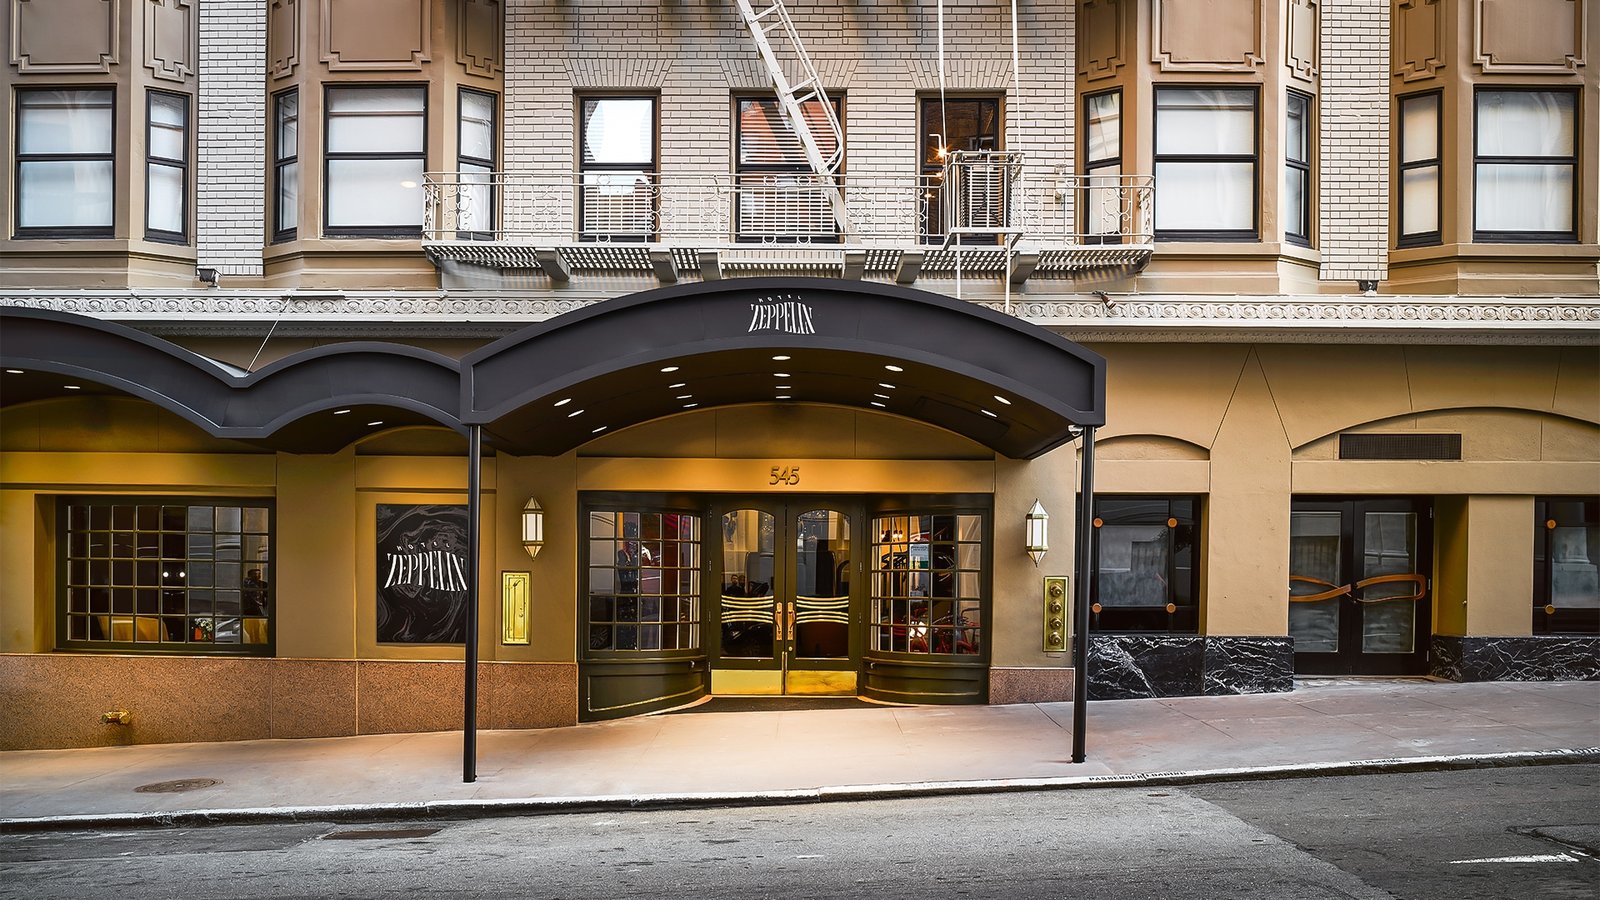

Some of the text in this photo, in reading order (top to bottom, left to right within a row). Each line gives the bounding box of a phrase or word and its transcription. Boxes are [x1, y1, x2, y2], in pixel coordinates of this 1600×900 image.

[758, 294, 802, 303] HOTEL
[748, 302, 816, 335] ZEPPELIN
[769, 465, 800, 486] 545
[396, 541, 451, 552] HOTEL
[384, 550, 468, 592] ZEPPELIN
